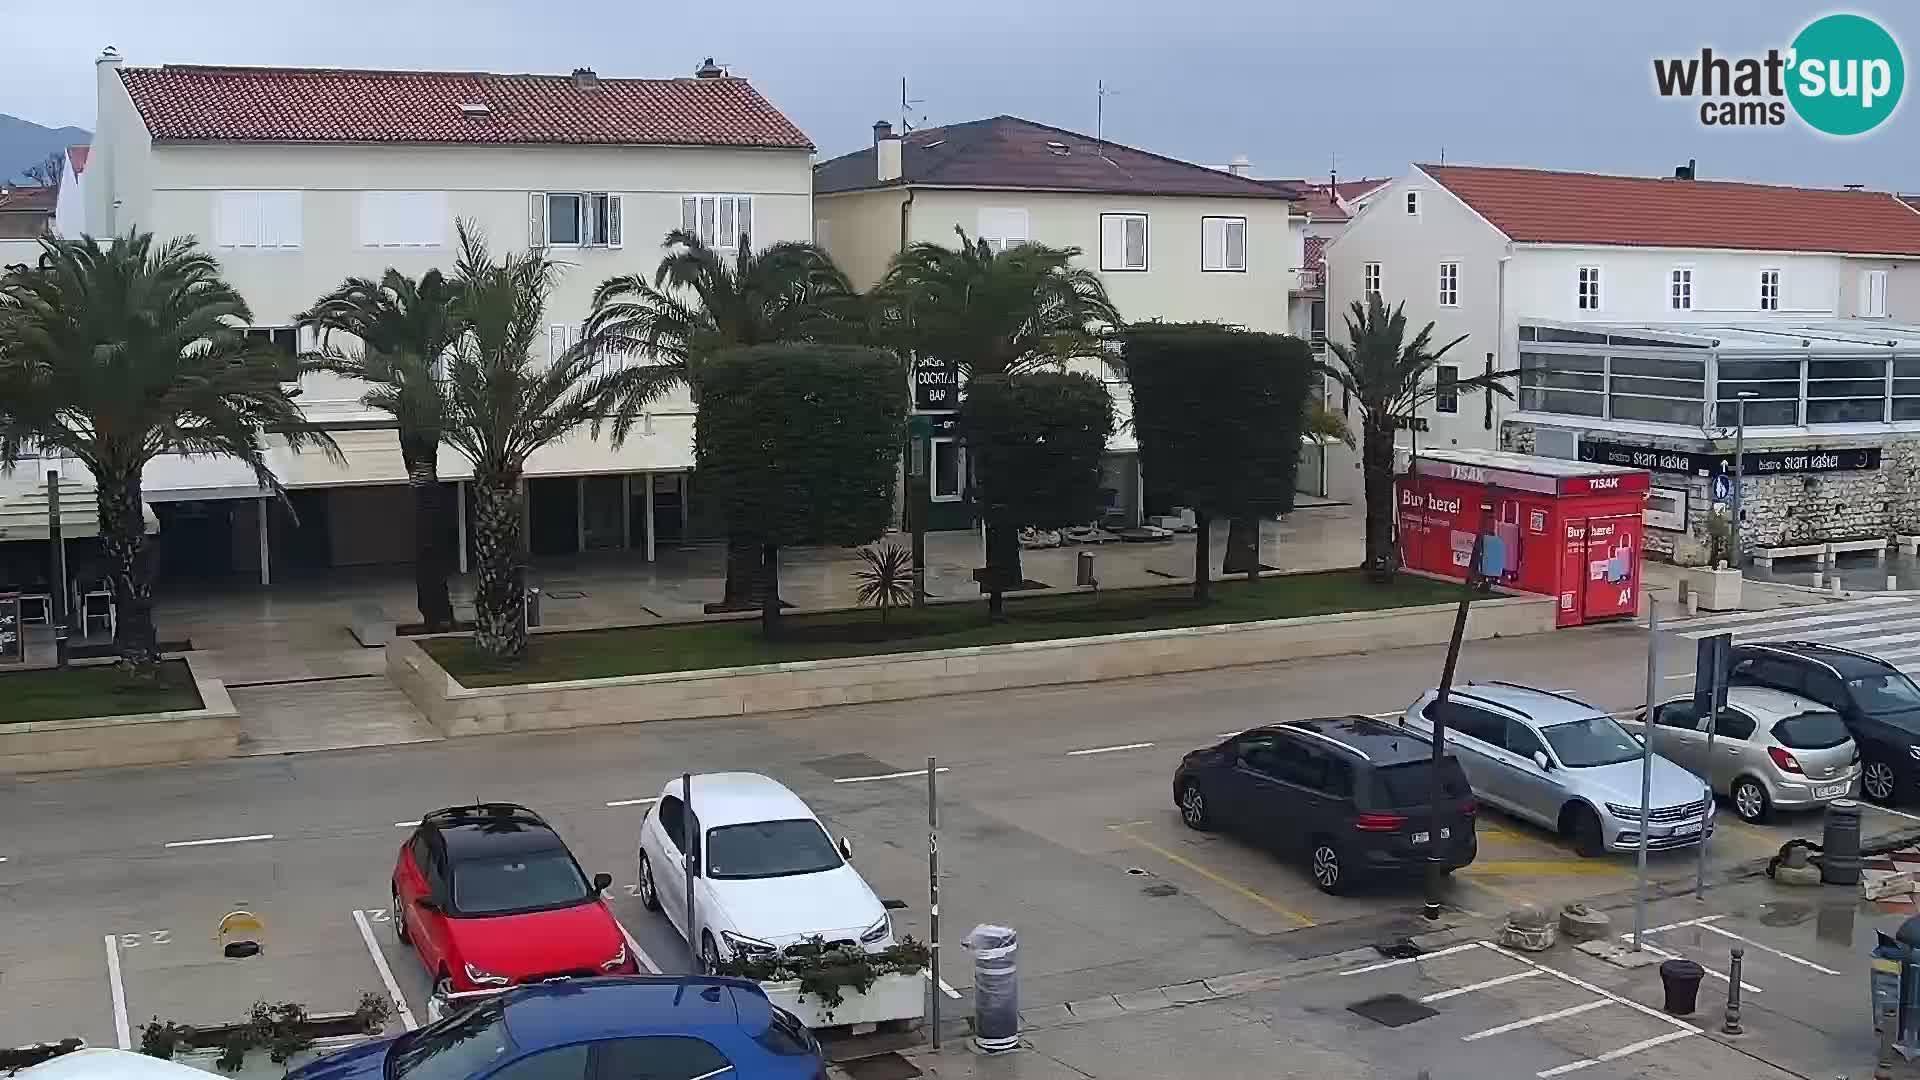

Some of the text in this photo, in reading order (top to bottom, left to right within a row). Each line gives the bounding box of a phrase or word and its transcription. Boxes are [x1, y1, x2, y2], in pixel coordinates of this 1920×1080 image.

[930, 390, 945, 400] BAR
[1590, 478, 1618, 489] TISAK
[1428, 492, 1460, 514] here!
[1567, 523, 1615, 540] Buy here!
[1618, 588, 1631, 605] A1
